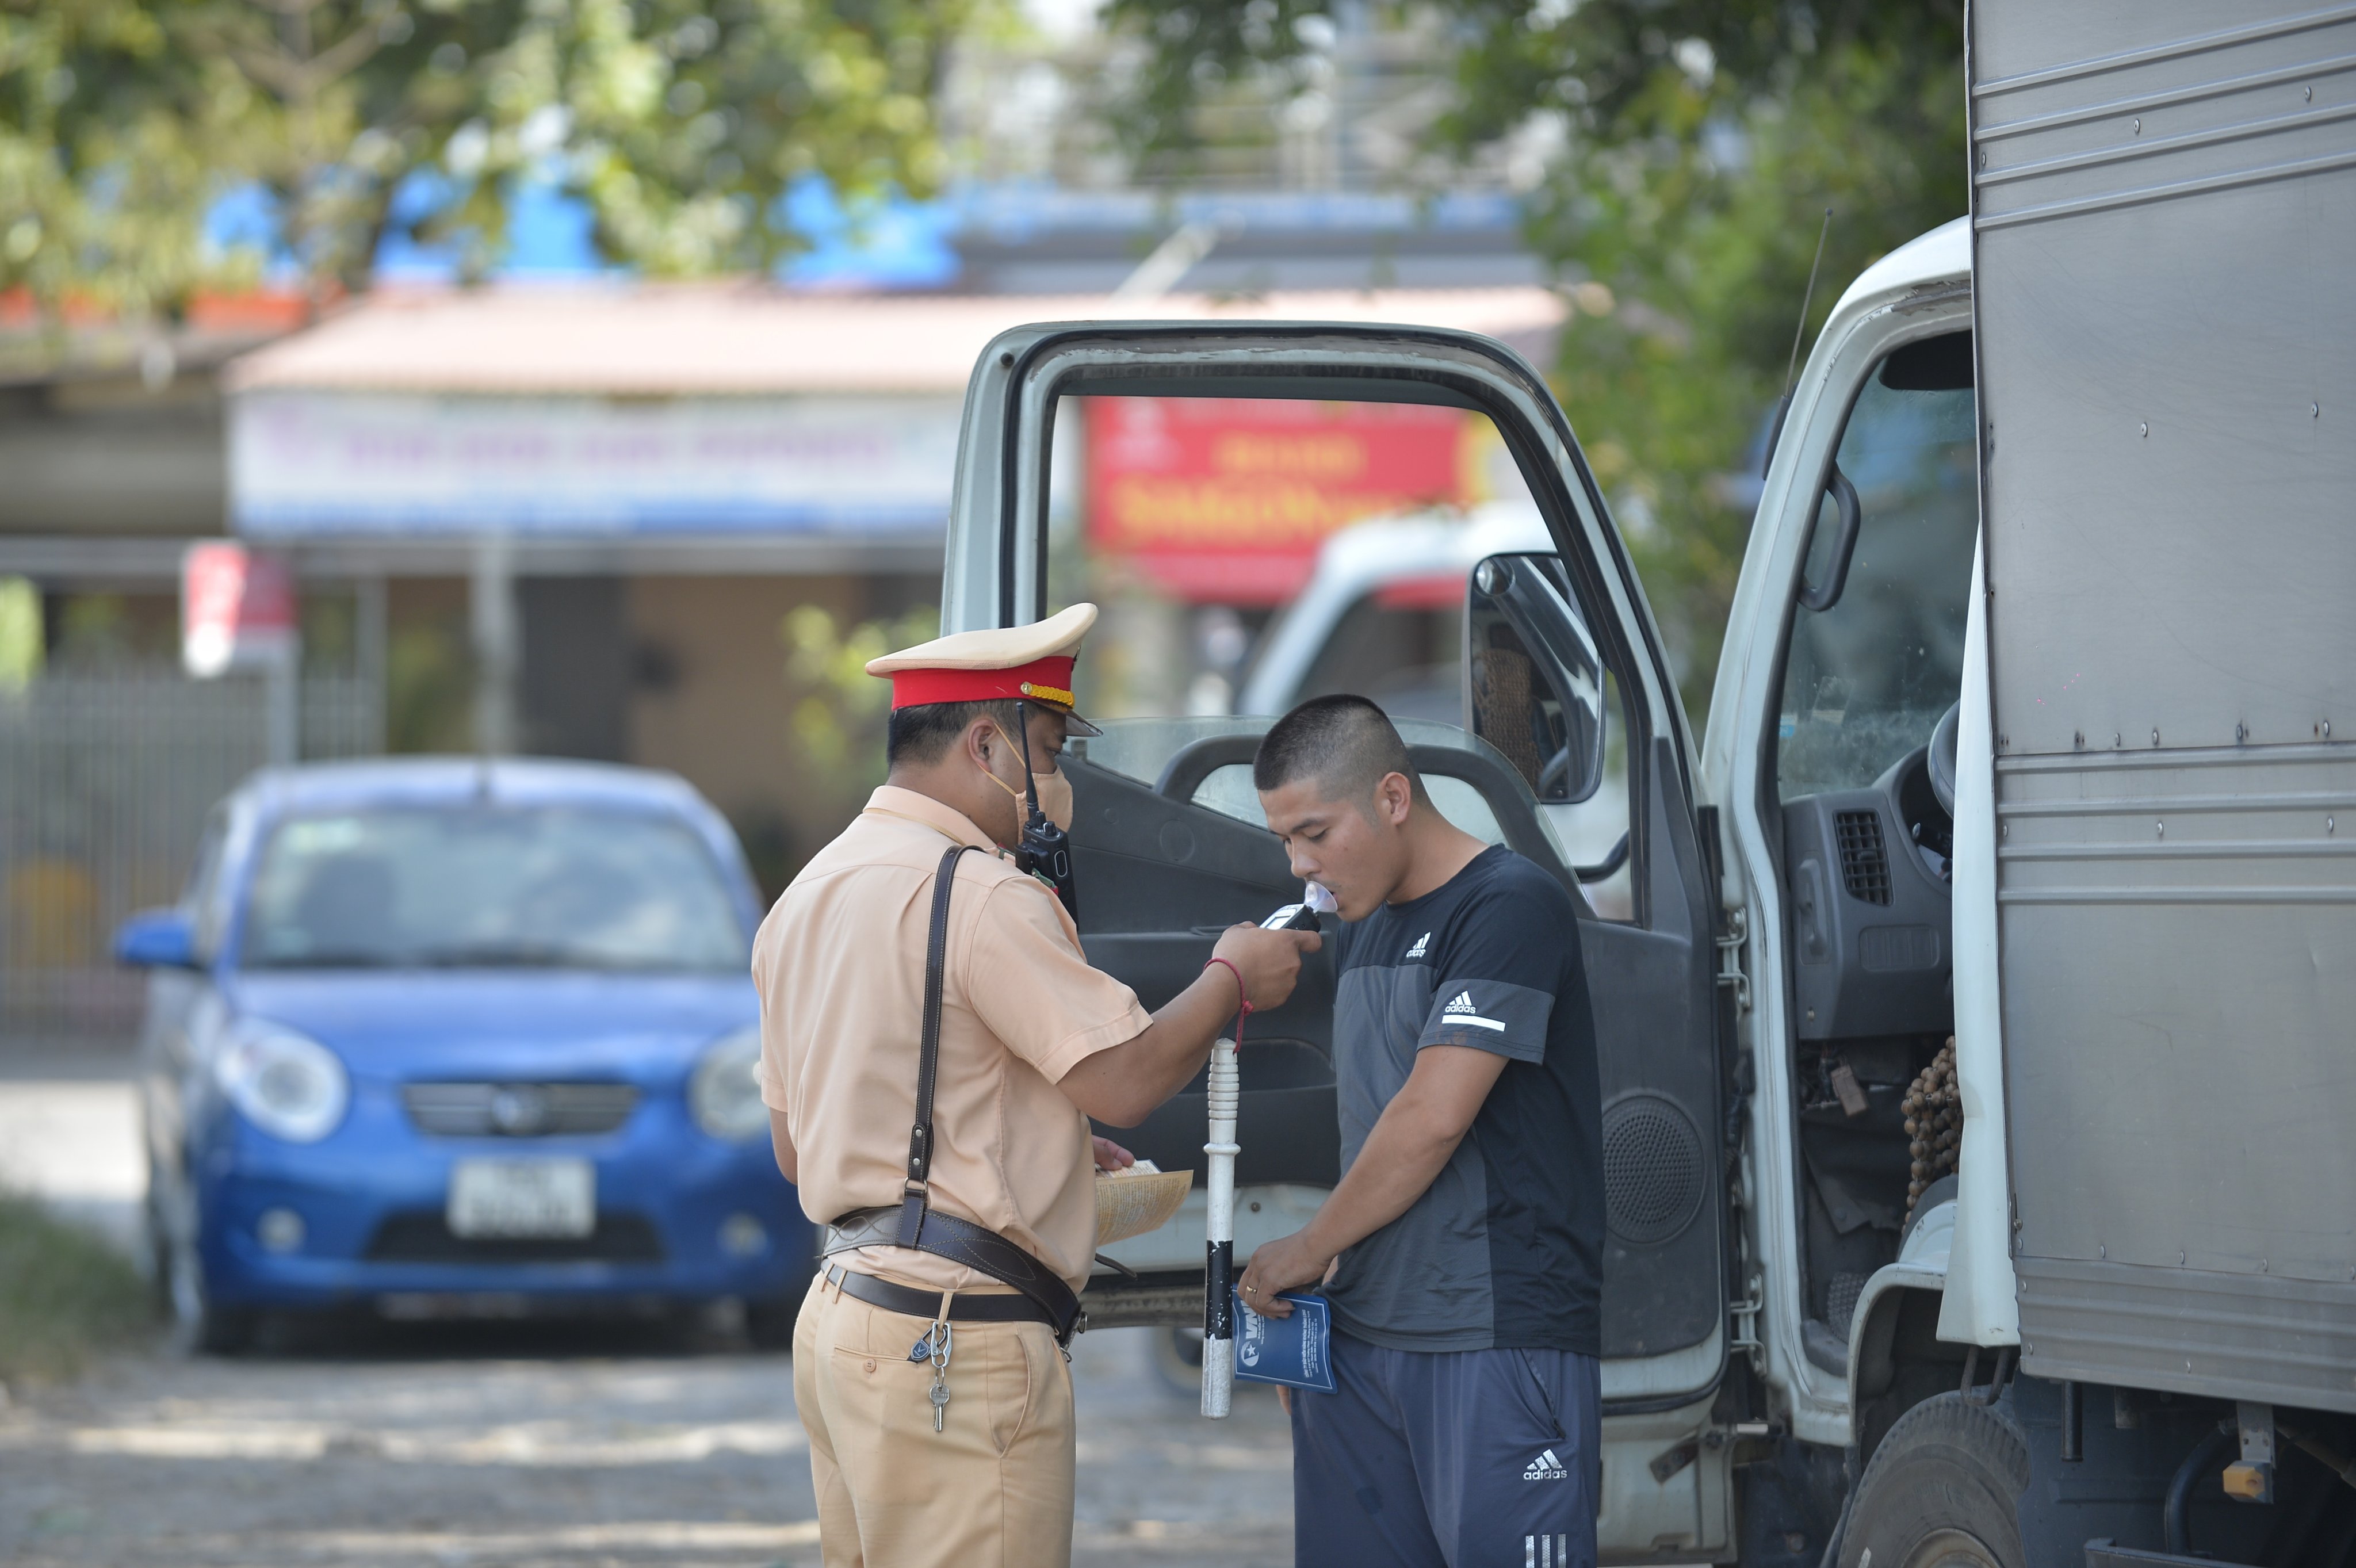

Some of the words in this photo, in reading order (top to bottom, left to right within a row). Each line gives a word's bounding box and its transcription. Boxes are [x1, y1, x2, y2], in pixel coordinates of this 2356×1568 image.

[1406, 948, 1426, 958] adds
[1445, 1004, 1476, 1014] adidas
[1524, 1469, 1567, 1480] adidas
